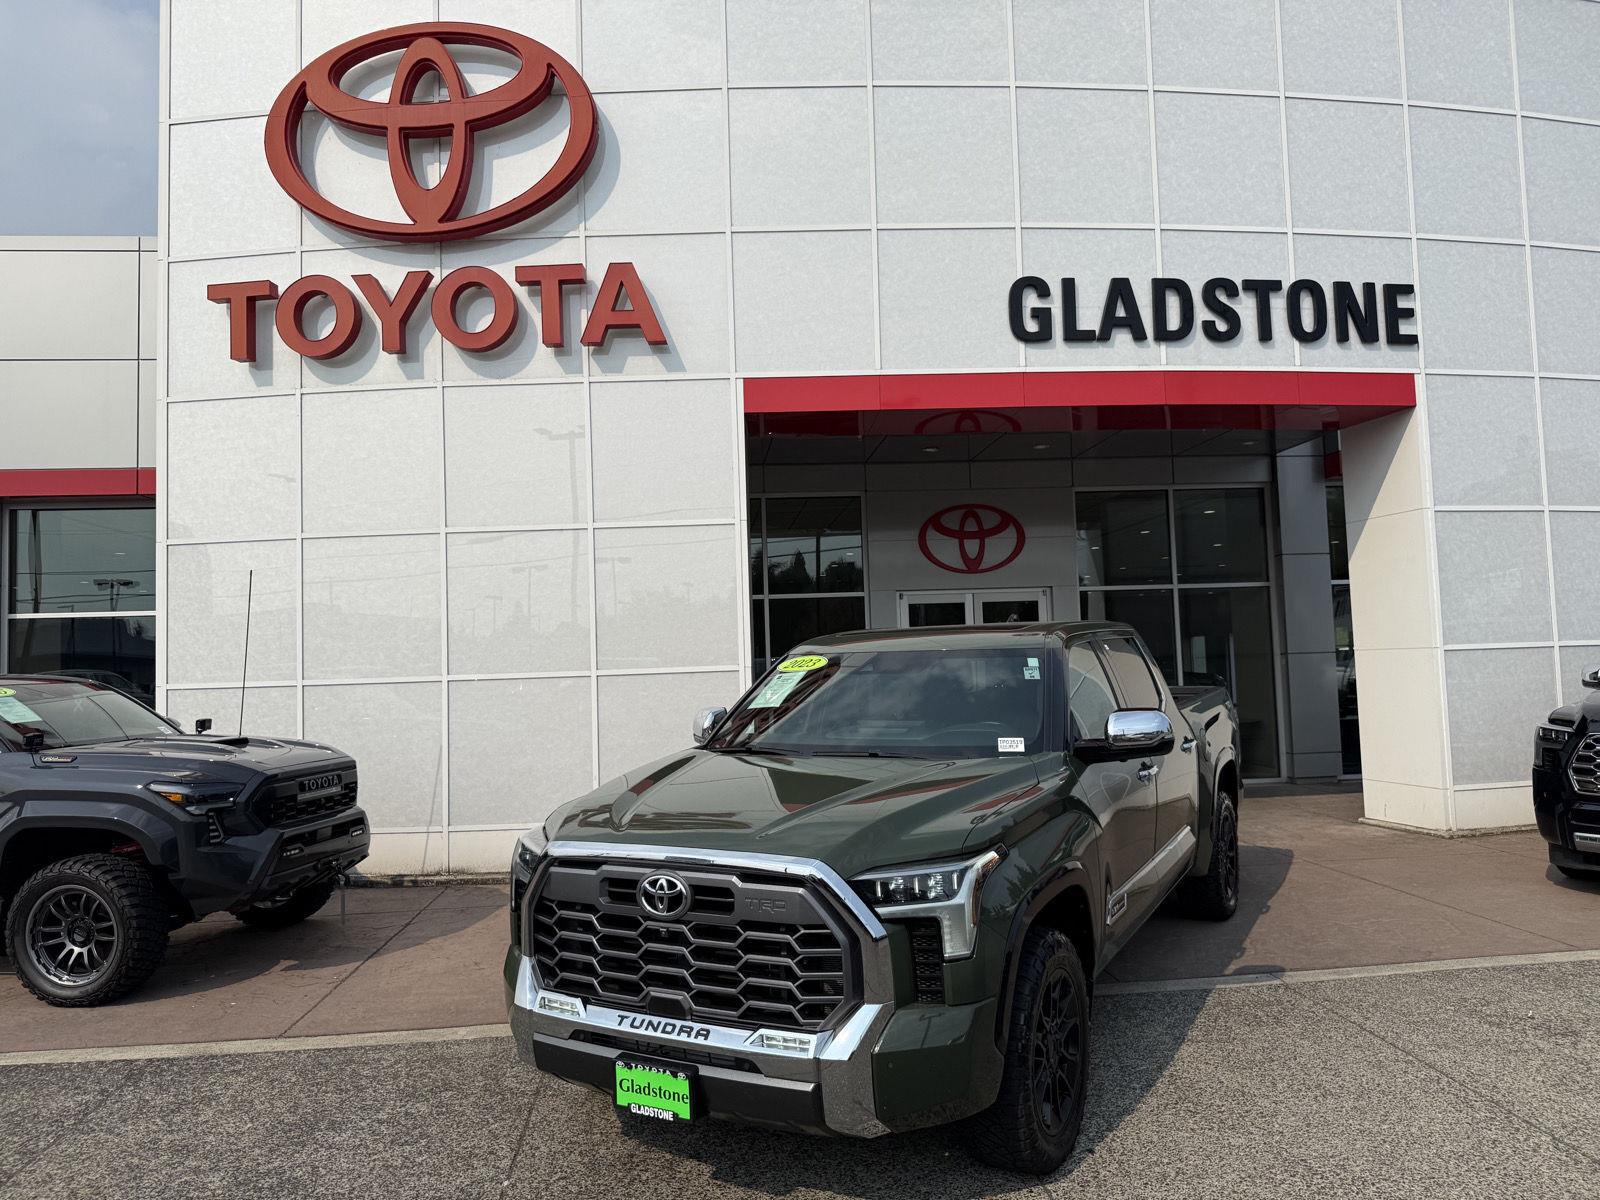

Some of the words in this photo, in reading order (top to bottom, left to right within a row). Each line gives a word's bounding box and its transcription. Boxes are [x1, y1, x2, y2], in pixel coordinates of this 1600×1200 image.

[207, 262, 668, 362] TOYOTA
[1008, 275, 1419, 344] GLADSTONE
[303, 775, 339, 790] TOYOTA
[744, 896, 788, 914] TRD
[617, 1014, 711, 1040] TUNDRA
[630, 1063, 672, 1076] TOYOTA
[618, 1078, 689, 1104] Gladstone
[631, 1103, 674, 1120] GLADSTONE
